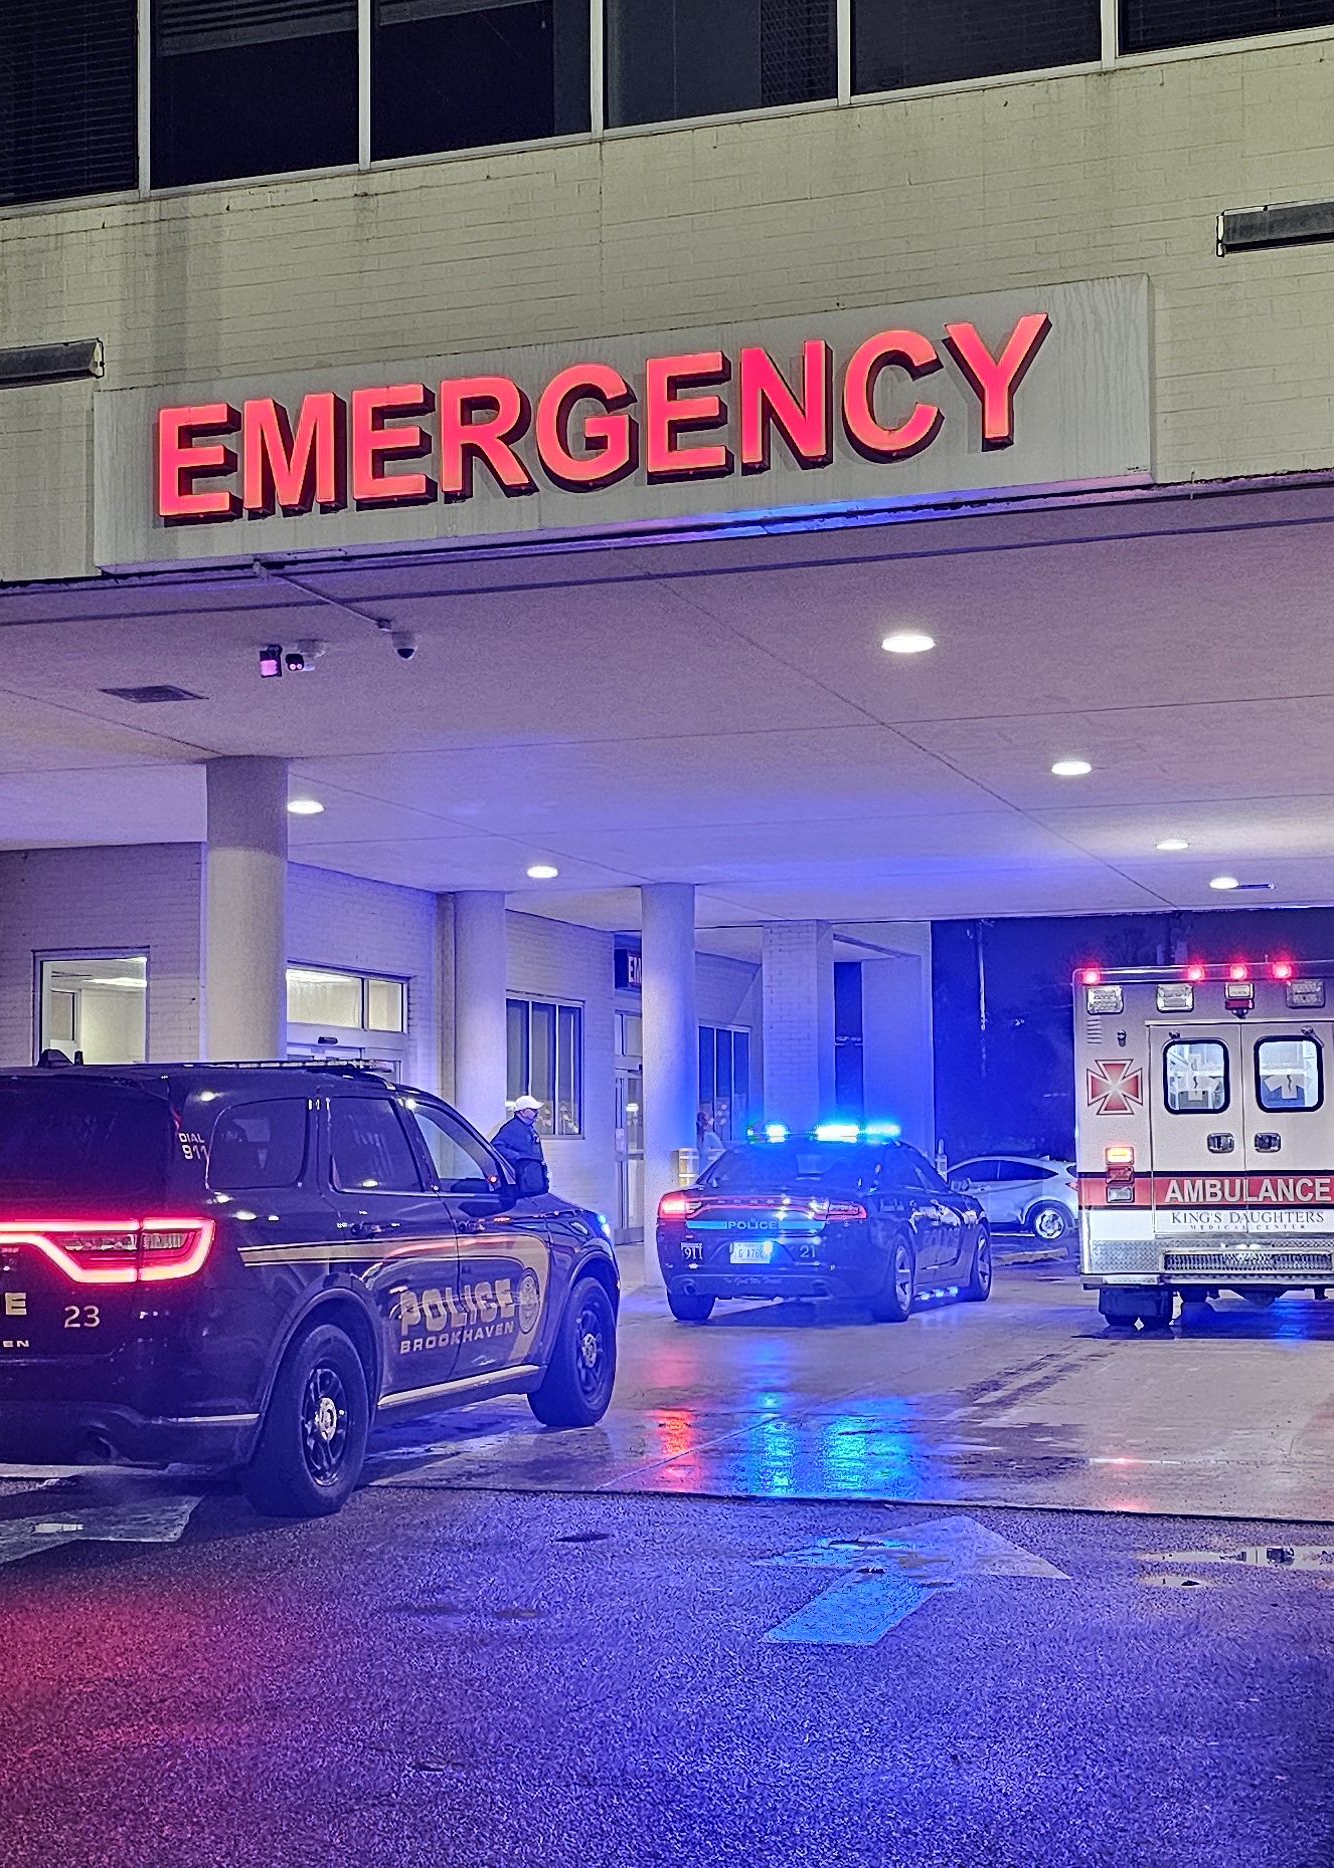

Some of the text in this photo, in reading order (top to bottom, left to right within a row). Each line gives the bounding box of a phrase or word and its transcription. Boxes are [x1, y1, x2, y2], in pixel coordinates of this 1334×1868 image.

[157, 312, 1052, 526] EMERGENCY
[178, 1132, 205, 1143] DIAL
[181, 1144, 210, 1160] 911
[1164, 1178, 1332, 1204] AMBULANCE
[728, 1220, 779, 1230] POLICE
[1171, 1211, 1325, 1225] KING'S DAUGHTERS
[684, 1247, 703, 1260] 911
[800, 1244, 817, 1259] 21
[399, 1278, 516, 1337] POLICE
[64, 1305, 101, 1328] 23
[399, 1320, 515, 1355] BROOKHAVEN
